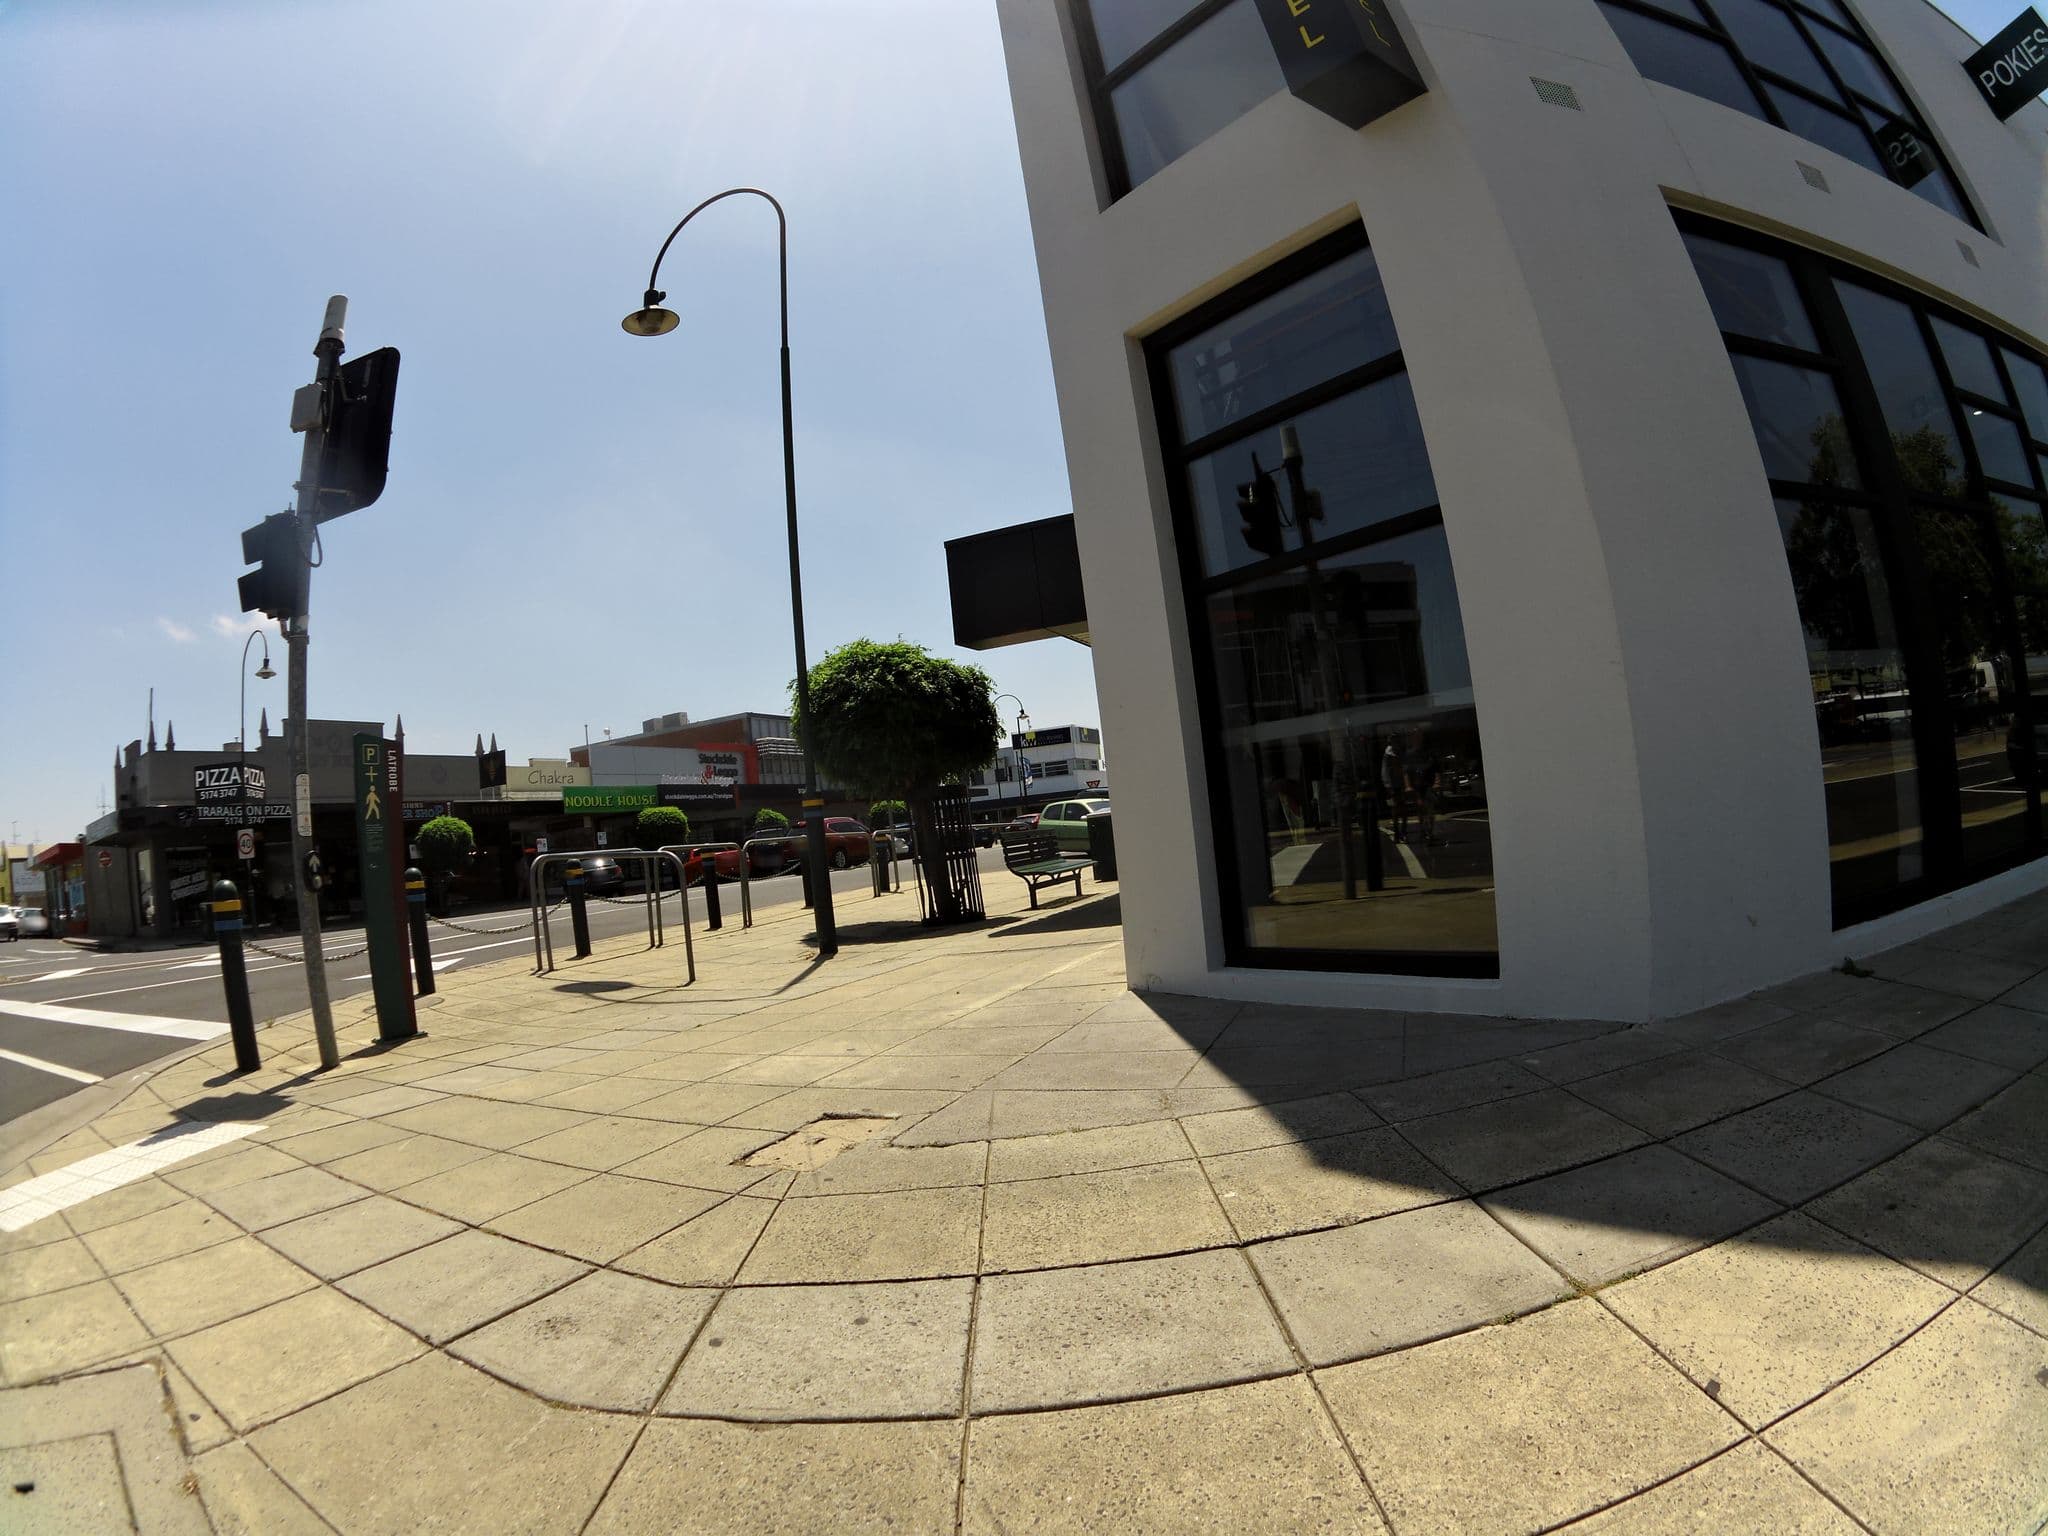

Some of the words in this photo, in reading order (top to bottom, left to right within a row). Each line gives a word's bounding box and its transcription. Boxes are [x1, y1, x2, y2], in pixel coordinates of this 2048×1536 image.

[1979, 28, 2048, 97] POKIES
[195, 767, 241, 788] PIZZA
[243, 767, 266, 788] PIZZA
[387, 750, 398, 792] LATROBE
[528, 770, 574, 785] Chakra
[200, 790, 218, 800] 5174
[219, 788, 238, 798] 3747
[618, 794, 657, 806] HOUSE
[264, 805, 292, 815] PIZZA
